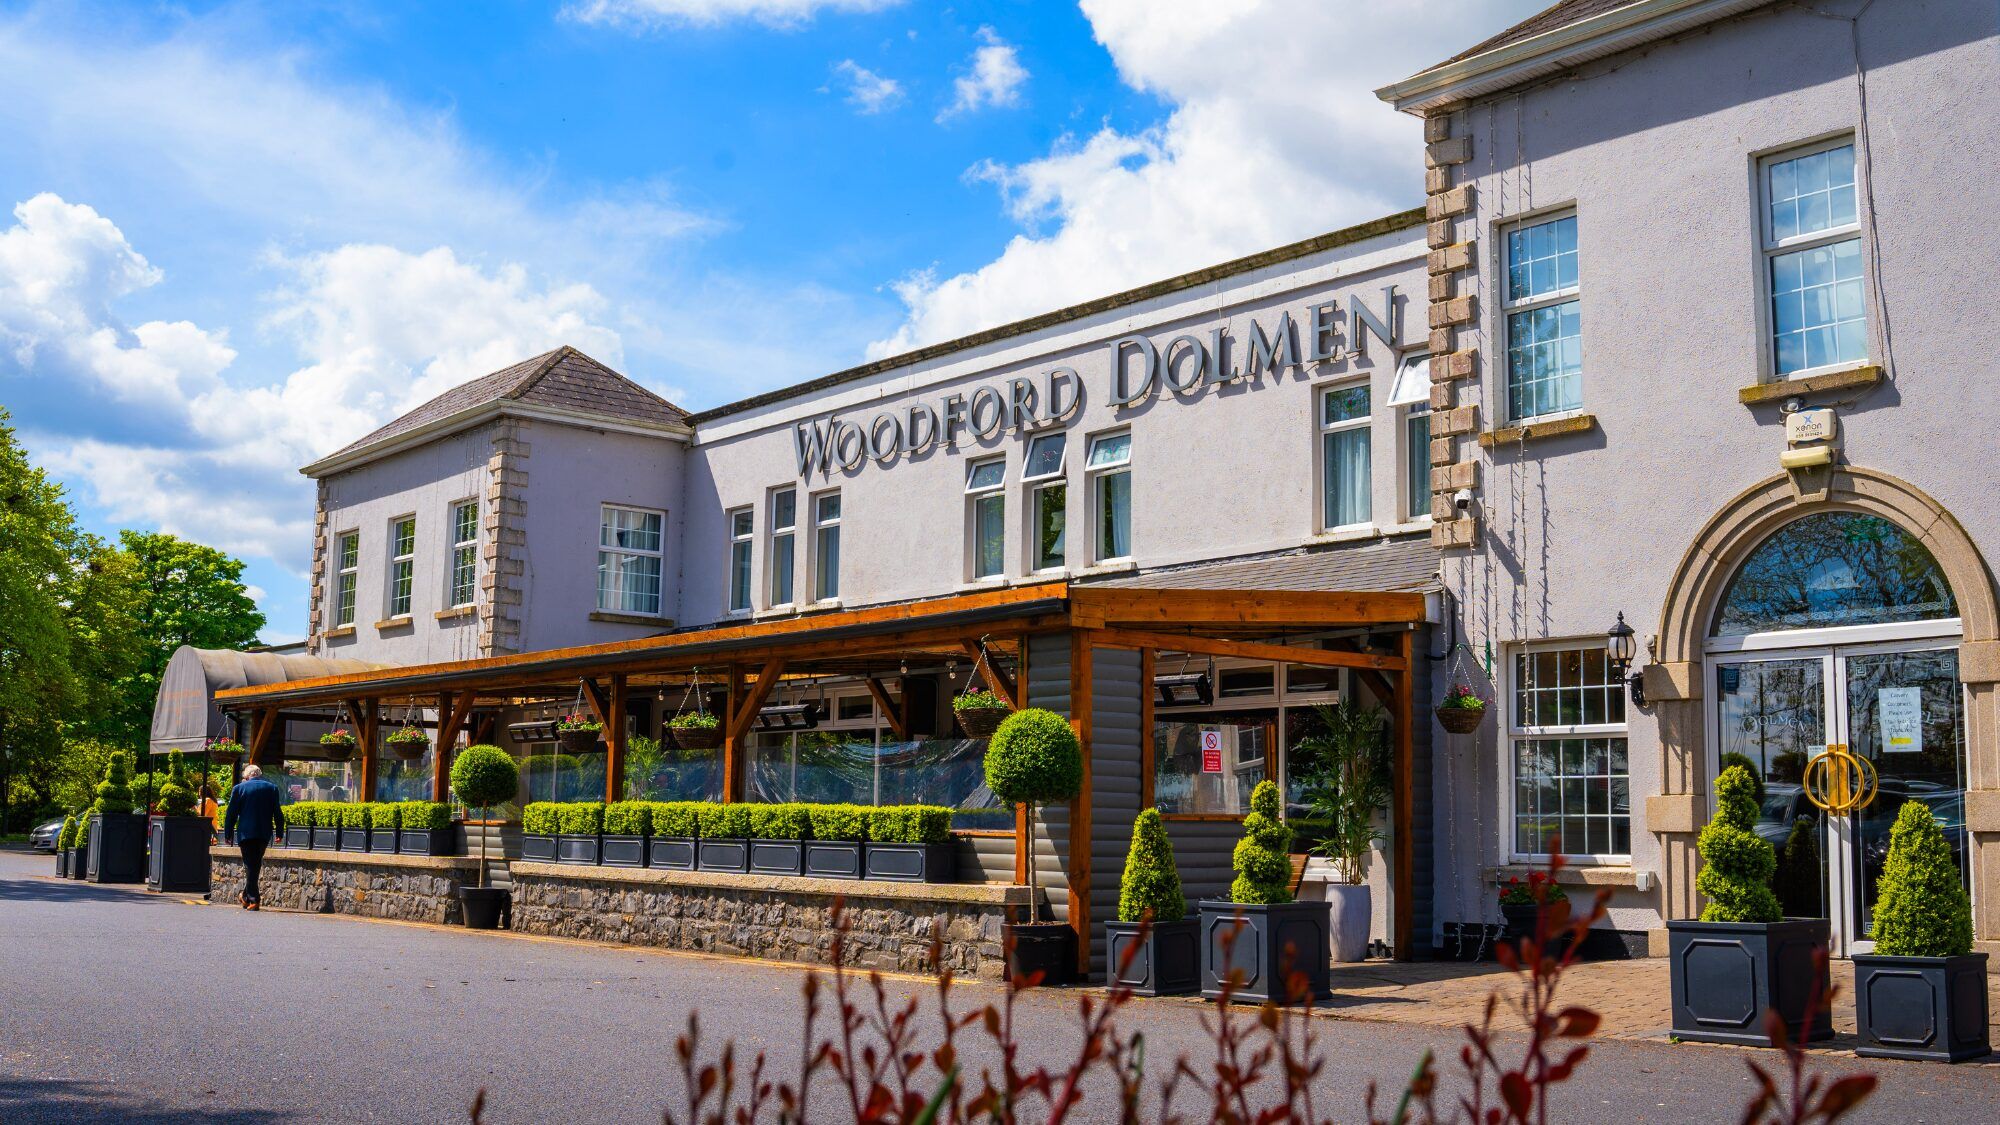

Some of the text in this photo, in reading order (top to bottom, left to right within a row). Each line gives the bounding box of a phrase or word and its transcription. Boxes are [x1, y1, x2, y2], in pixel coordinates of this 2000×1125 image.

[791, 284, 1399, 478] WOODFORD DOLMEN
[1796, 423, 1822, 432] xenon
